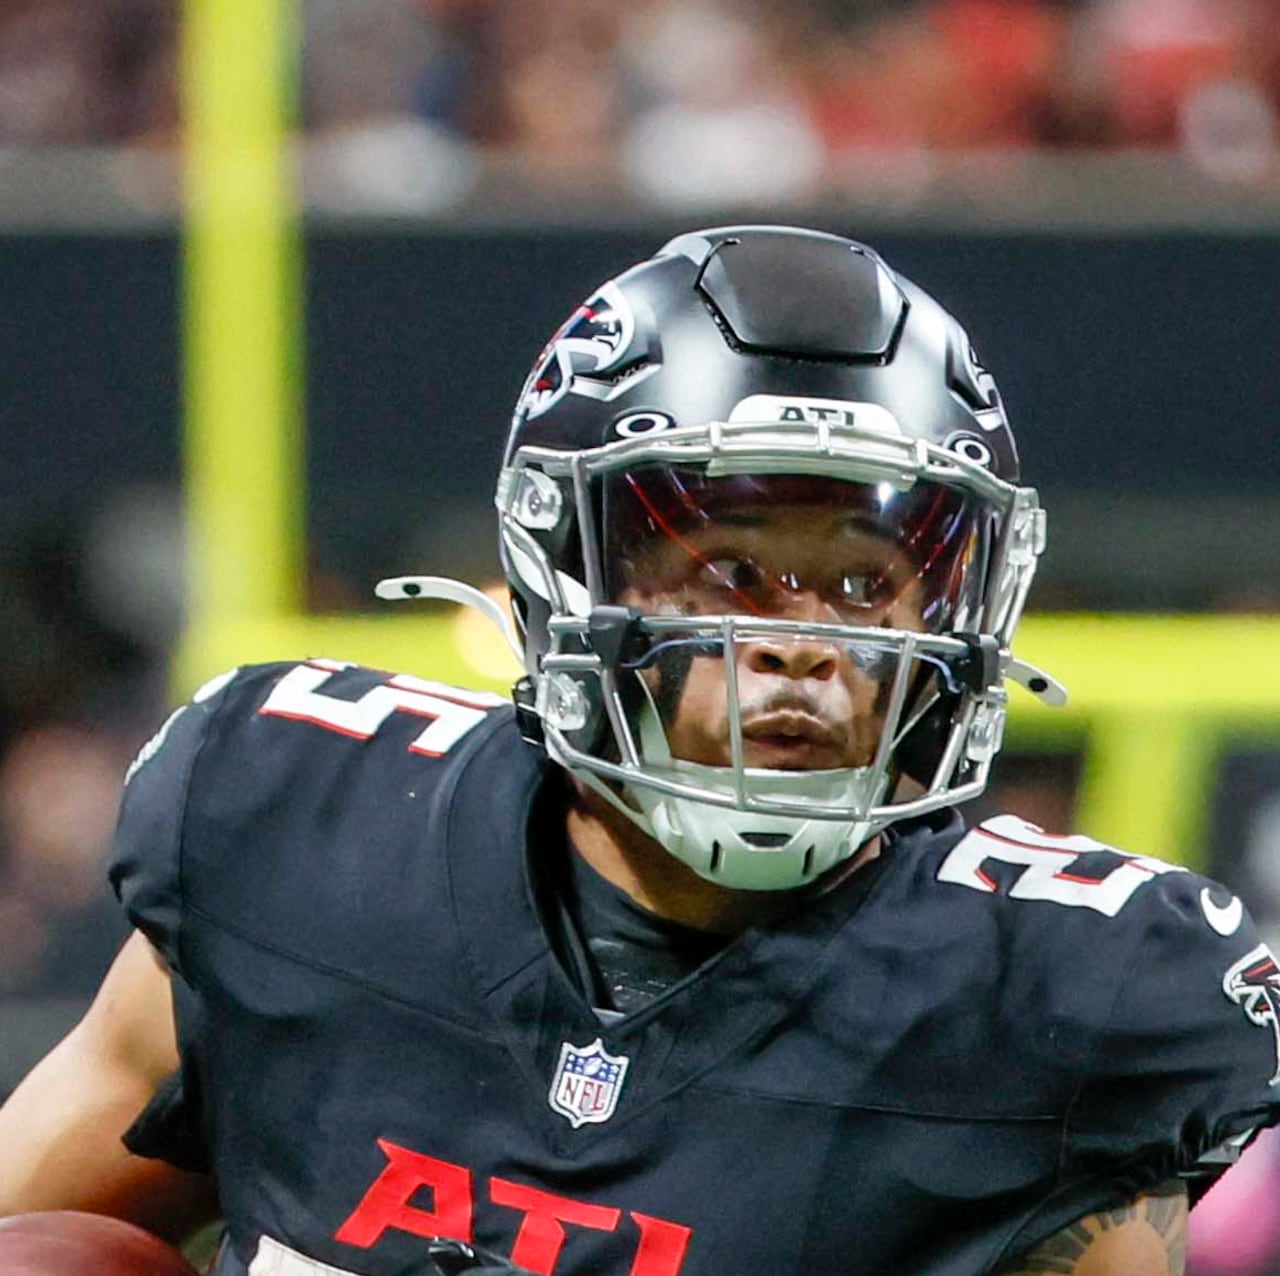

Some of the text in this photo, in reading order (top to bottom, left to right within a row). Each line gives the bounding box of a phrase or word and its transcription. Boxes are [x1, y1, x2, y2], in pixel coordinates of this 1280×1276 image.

[258, 657, 514, 758] 5
[936, 814, 1189, 917] 2
[562, 1077, 606, 1112] NFL
